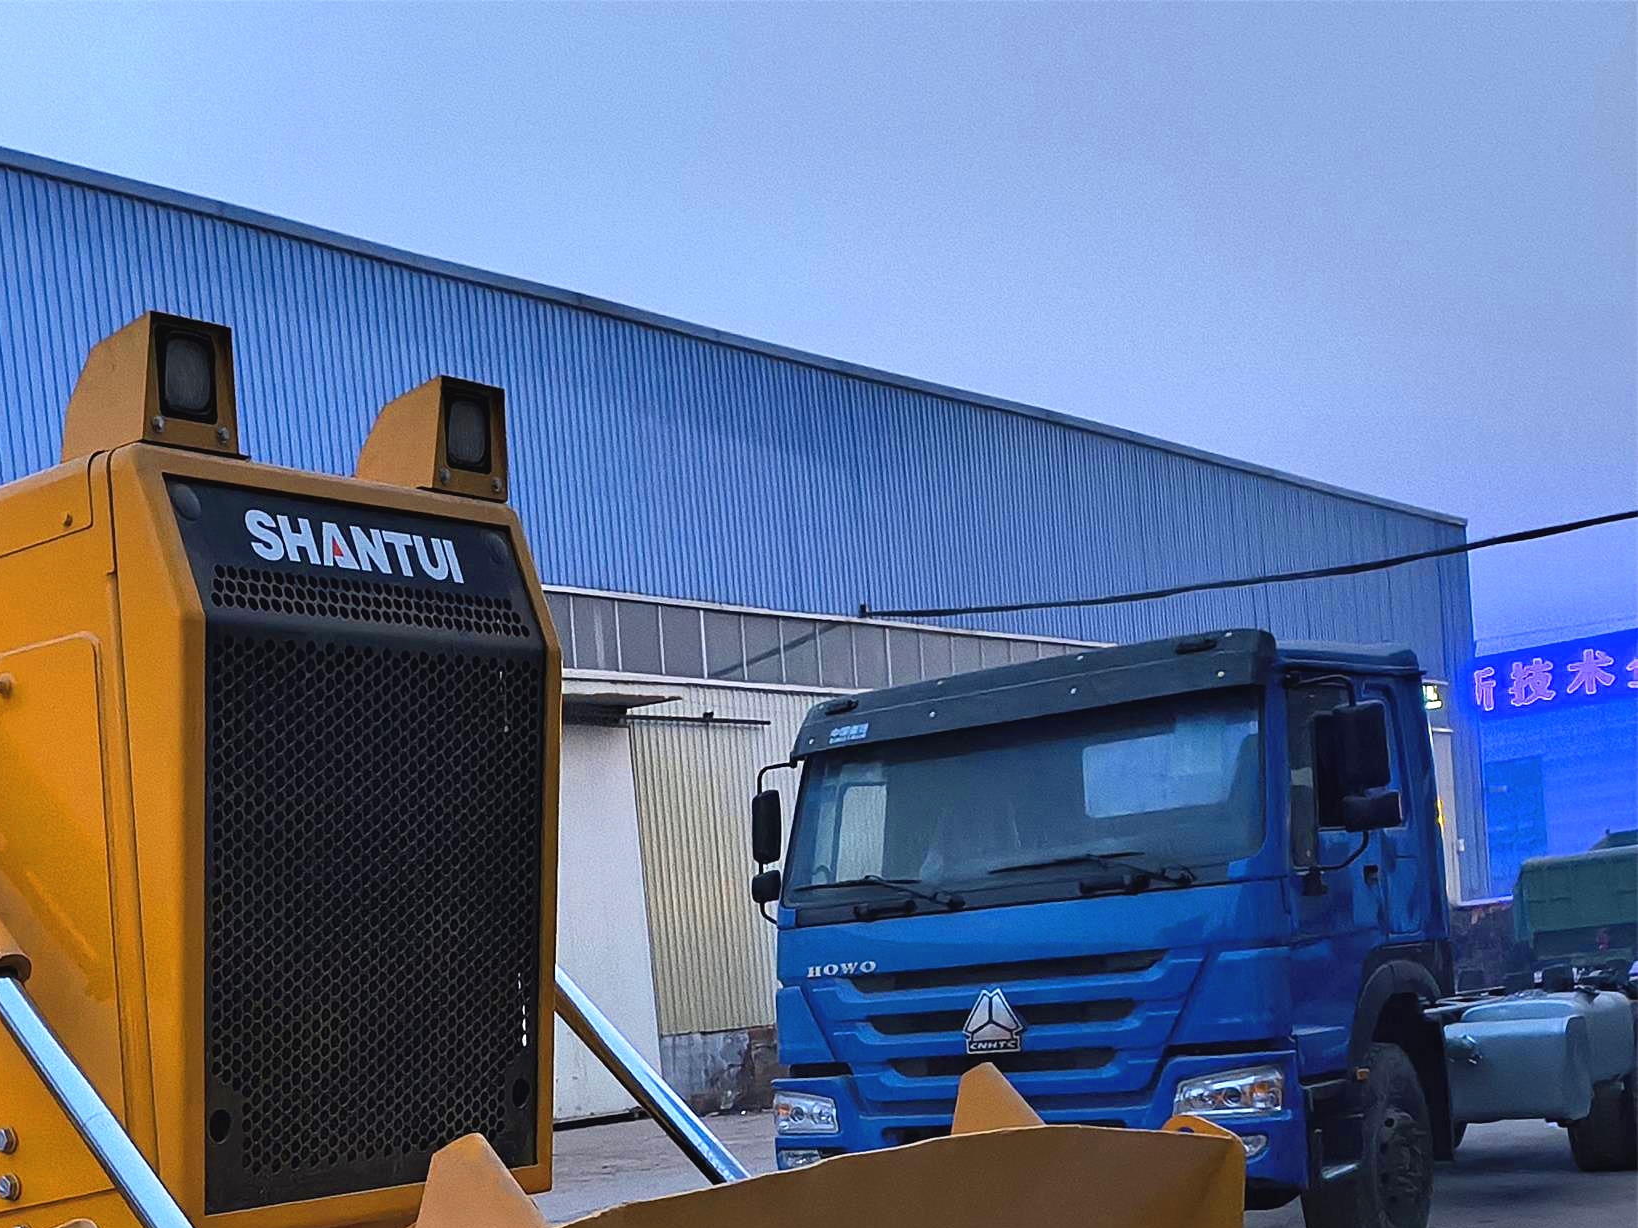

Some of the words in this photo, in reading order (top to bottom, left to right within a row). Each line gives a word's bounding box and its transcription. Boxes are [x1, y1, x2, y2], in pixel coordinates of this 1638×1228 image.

[244, 508, 465, 584] SHANTUI
[1474, 648, 1638, 711] 技术
[807, 960, 877, 978] HOWO
[969, 1040, 1016, 1050] CNHTC
